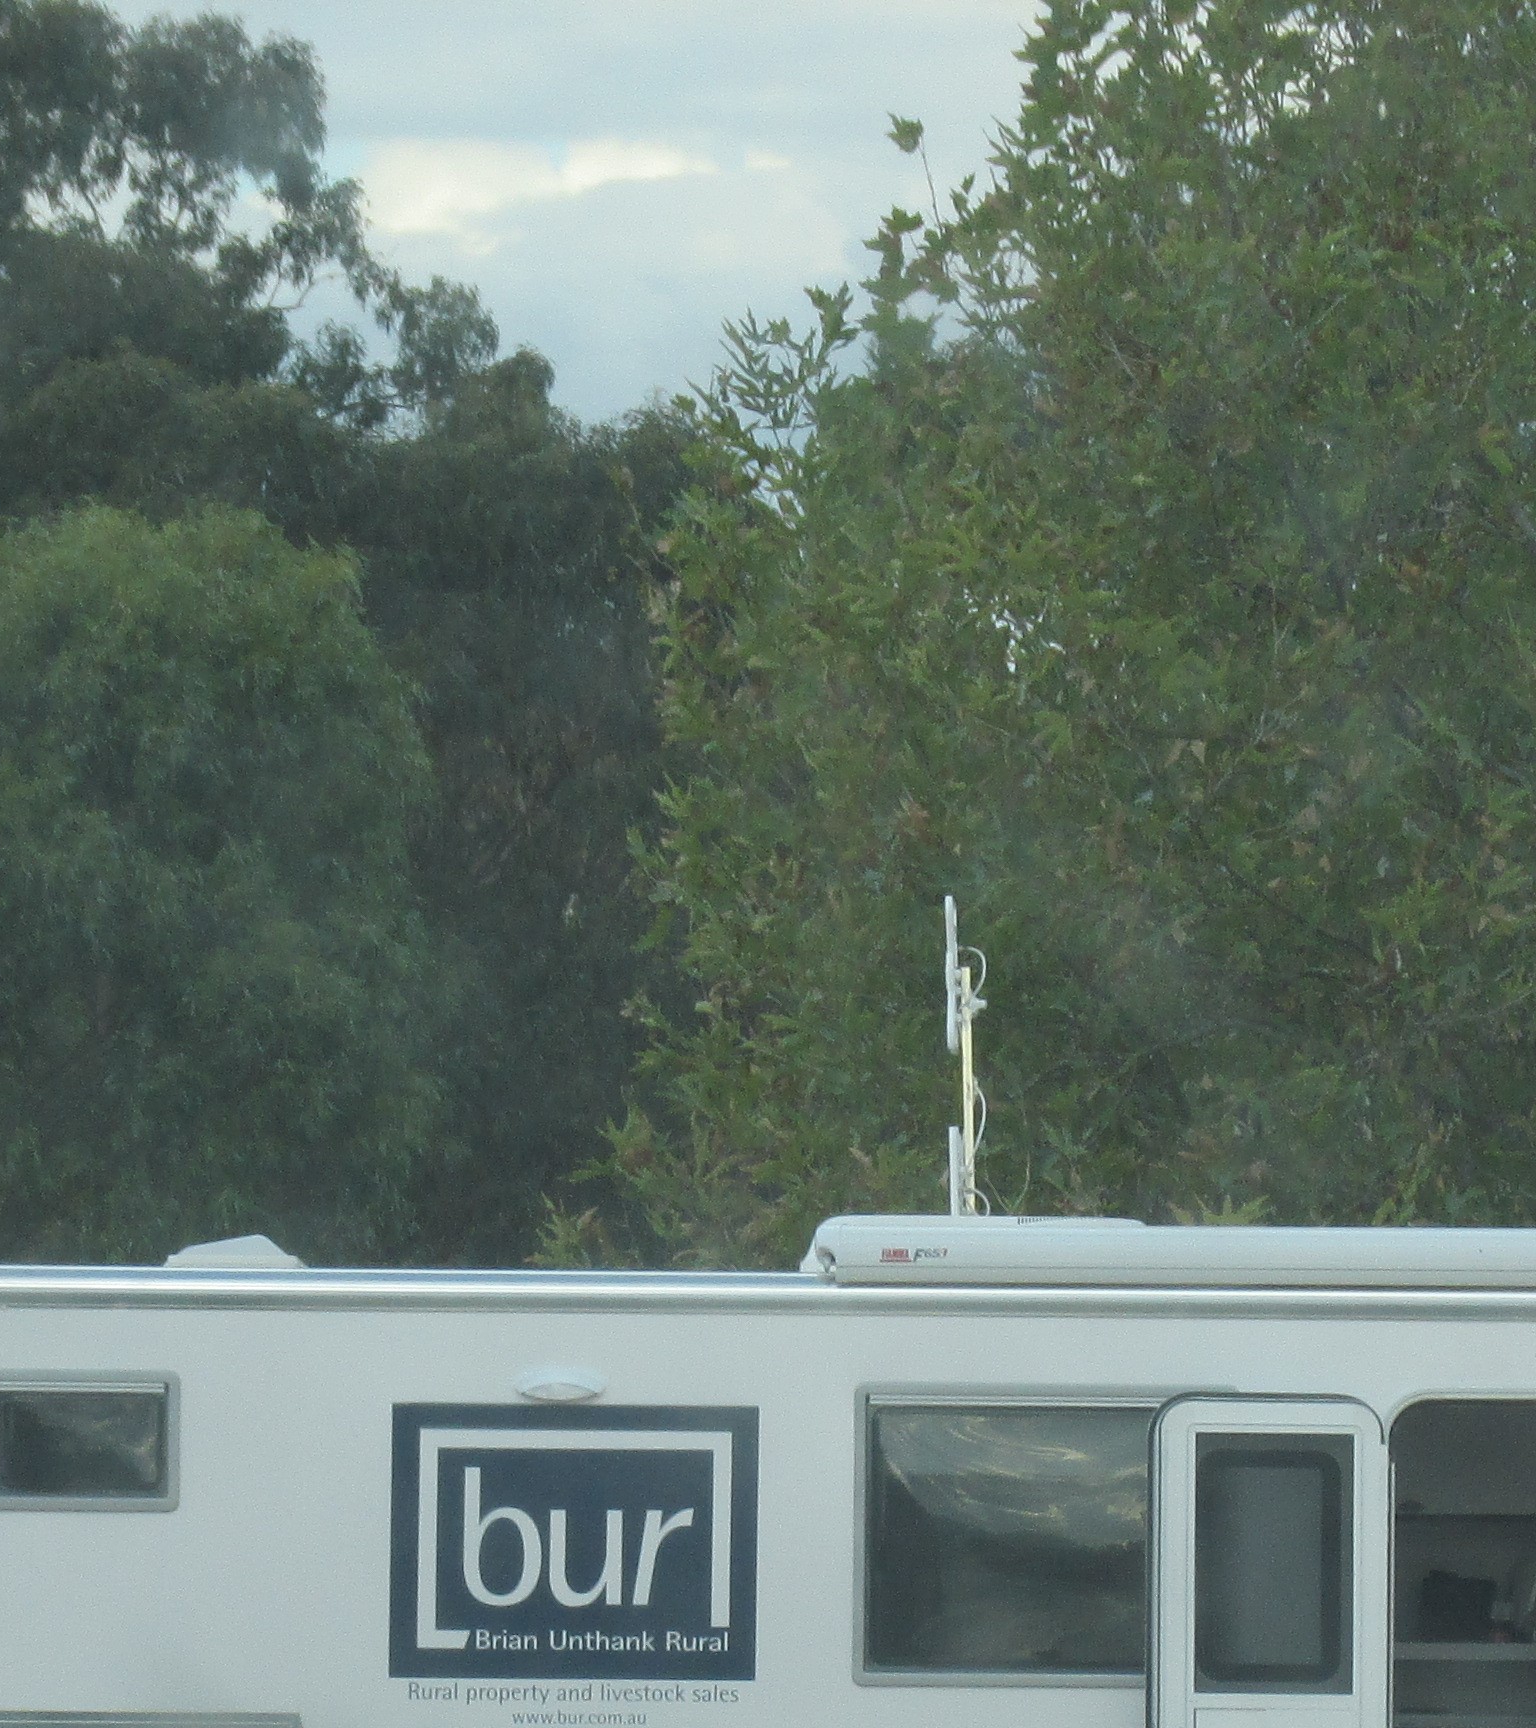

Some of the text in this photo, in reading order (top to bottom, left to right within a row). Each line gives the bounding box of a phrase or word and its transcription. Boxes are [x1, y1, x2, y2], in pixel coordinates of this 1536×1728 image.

[462, 1466, 694, 1608] bur
[475, 1628, 730, 1652] Brian Unthank Rural
[408, 1682, 740, 1705] Rural property and livestock sales
[512, 1709, 647, 1726] www.bur.com.au
